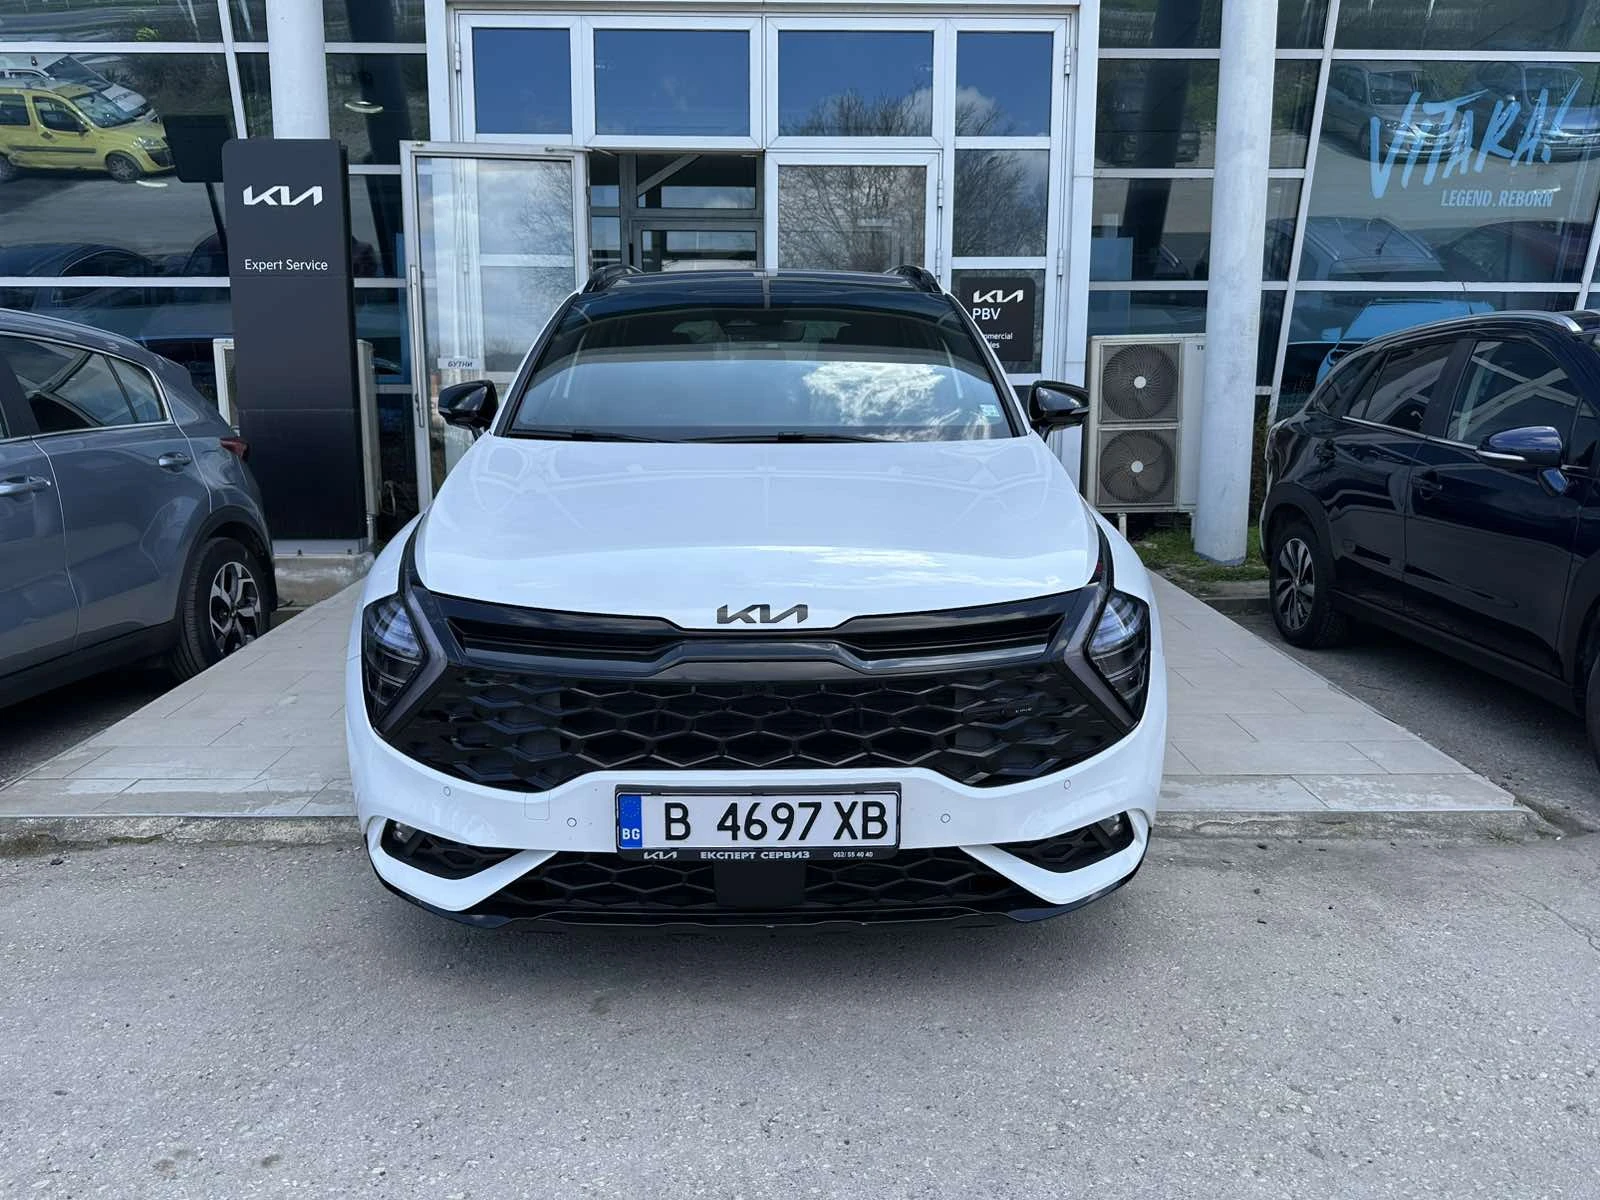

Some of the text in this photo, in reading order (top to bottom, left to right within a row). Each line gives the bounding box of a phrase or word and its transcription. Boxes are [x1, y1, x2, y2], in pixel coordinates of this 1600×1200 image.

[243, 185, 323, 206] KIA
[244, 259, 328, 272] Expert Service
[973, 290, 1024, 303] KIA
[972, 307, 1001, 320] PBV
[717, 604, 808, 624] KIA
[664, 800, 888, 841] B 4697 XB
[621, 828, 641, 841] BG
[643, 851, 678, 860] KIA
[700, 851, 811, 860] ЕКСПЕРТ СЕРВИЗ
